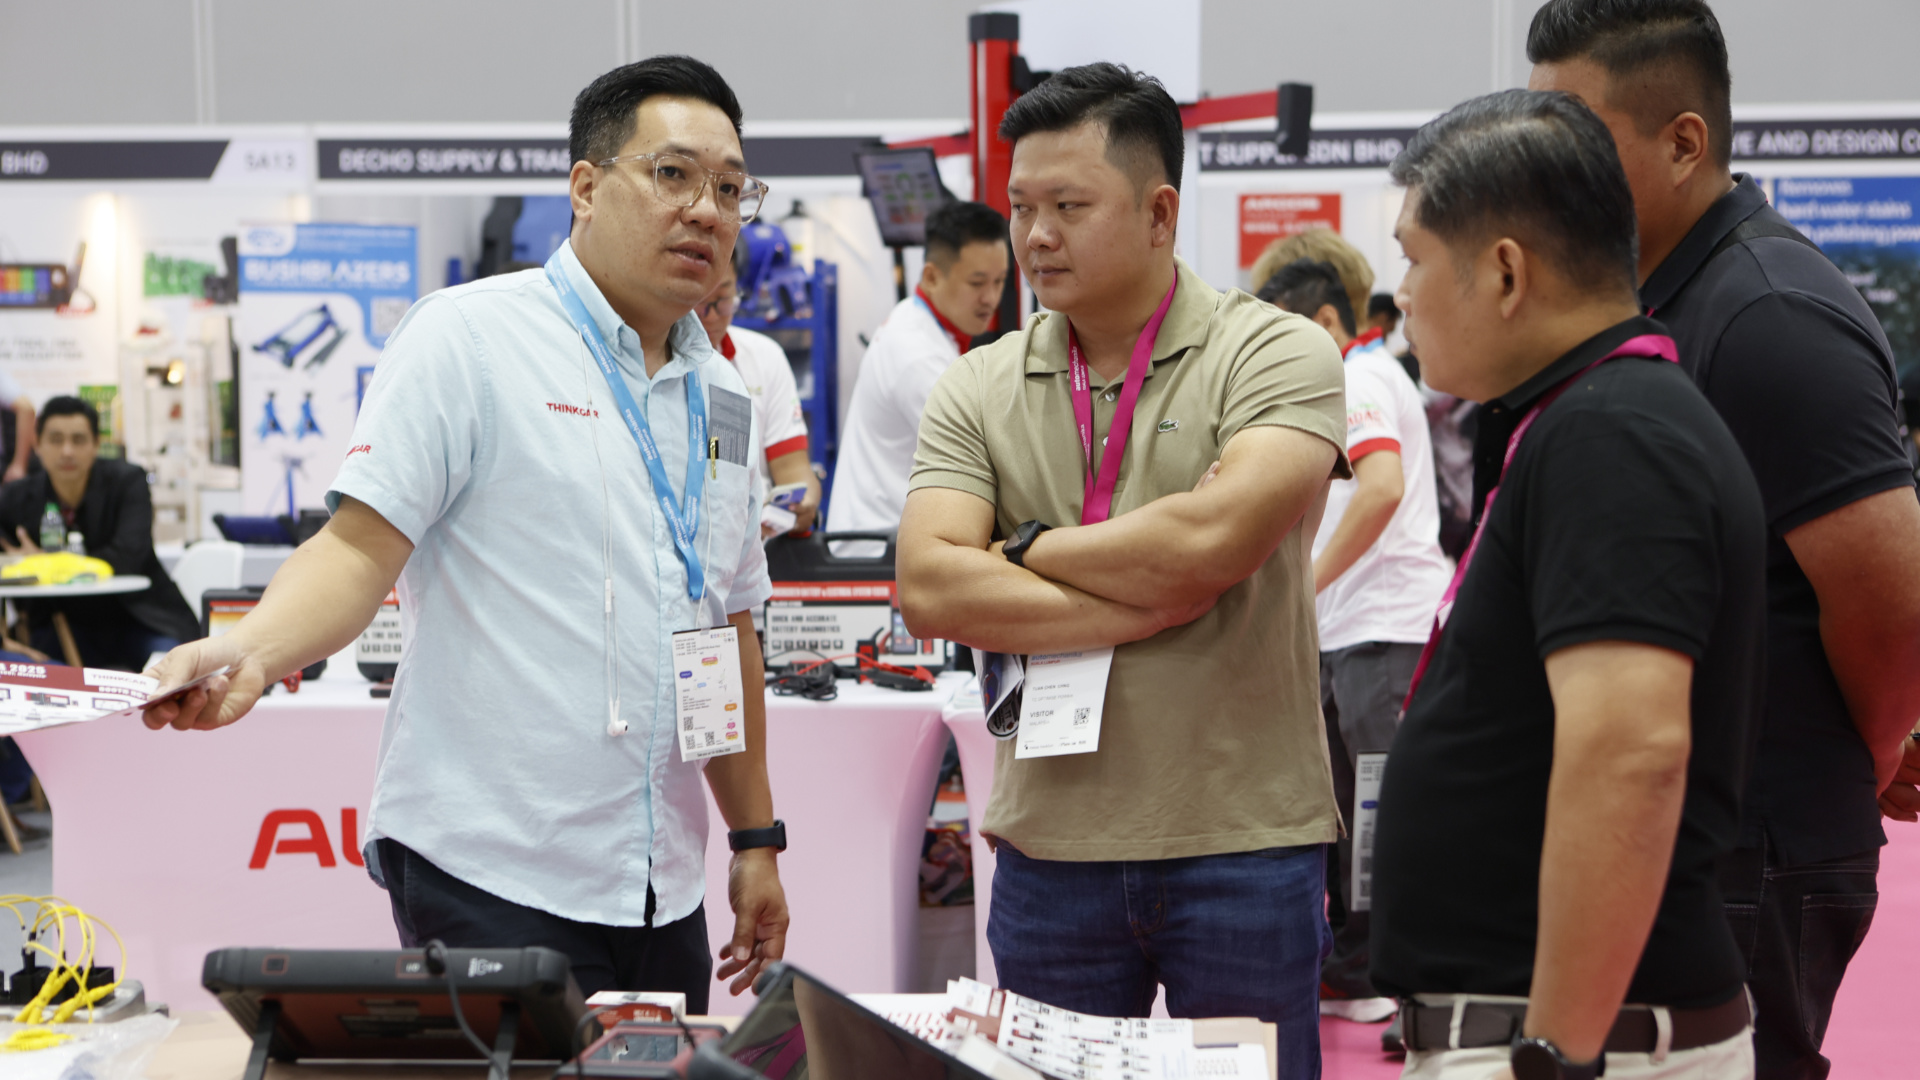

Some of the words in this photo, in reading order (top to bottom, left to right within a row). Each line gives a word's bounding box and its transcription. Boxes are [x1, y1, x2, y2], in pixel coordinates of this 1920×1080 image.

[1354, 139, 1402, 163] BHD
[1757, 130, 1809, 155] AND
[1811, 128, 1900, 155] DESIGN
[1901, 128, 1920, 154] C
[1, 150, 48, 174] BHD
[339, 148, 414, 172] DECHO
[416, 148, 497, 172] SUPPLY
[498, 149, 517, 172] &
[546, 402, 599, 419] THINKCAR
[625, 408, 654, 461] automechanika
[10, 663, 46, 675] 2025
[1030, 709, 1054, 718] VISITOR
